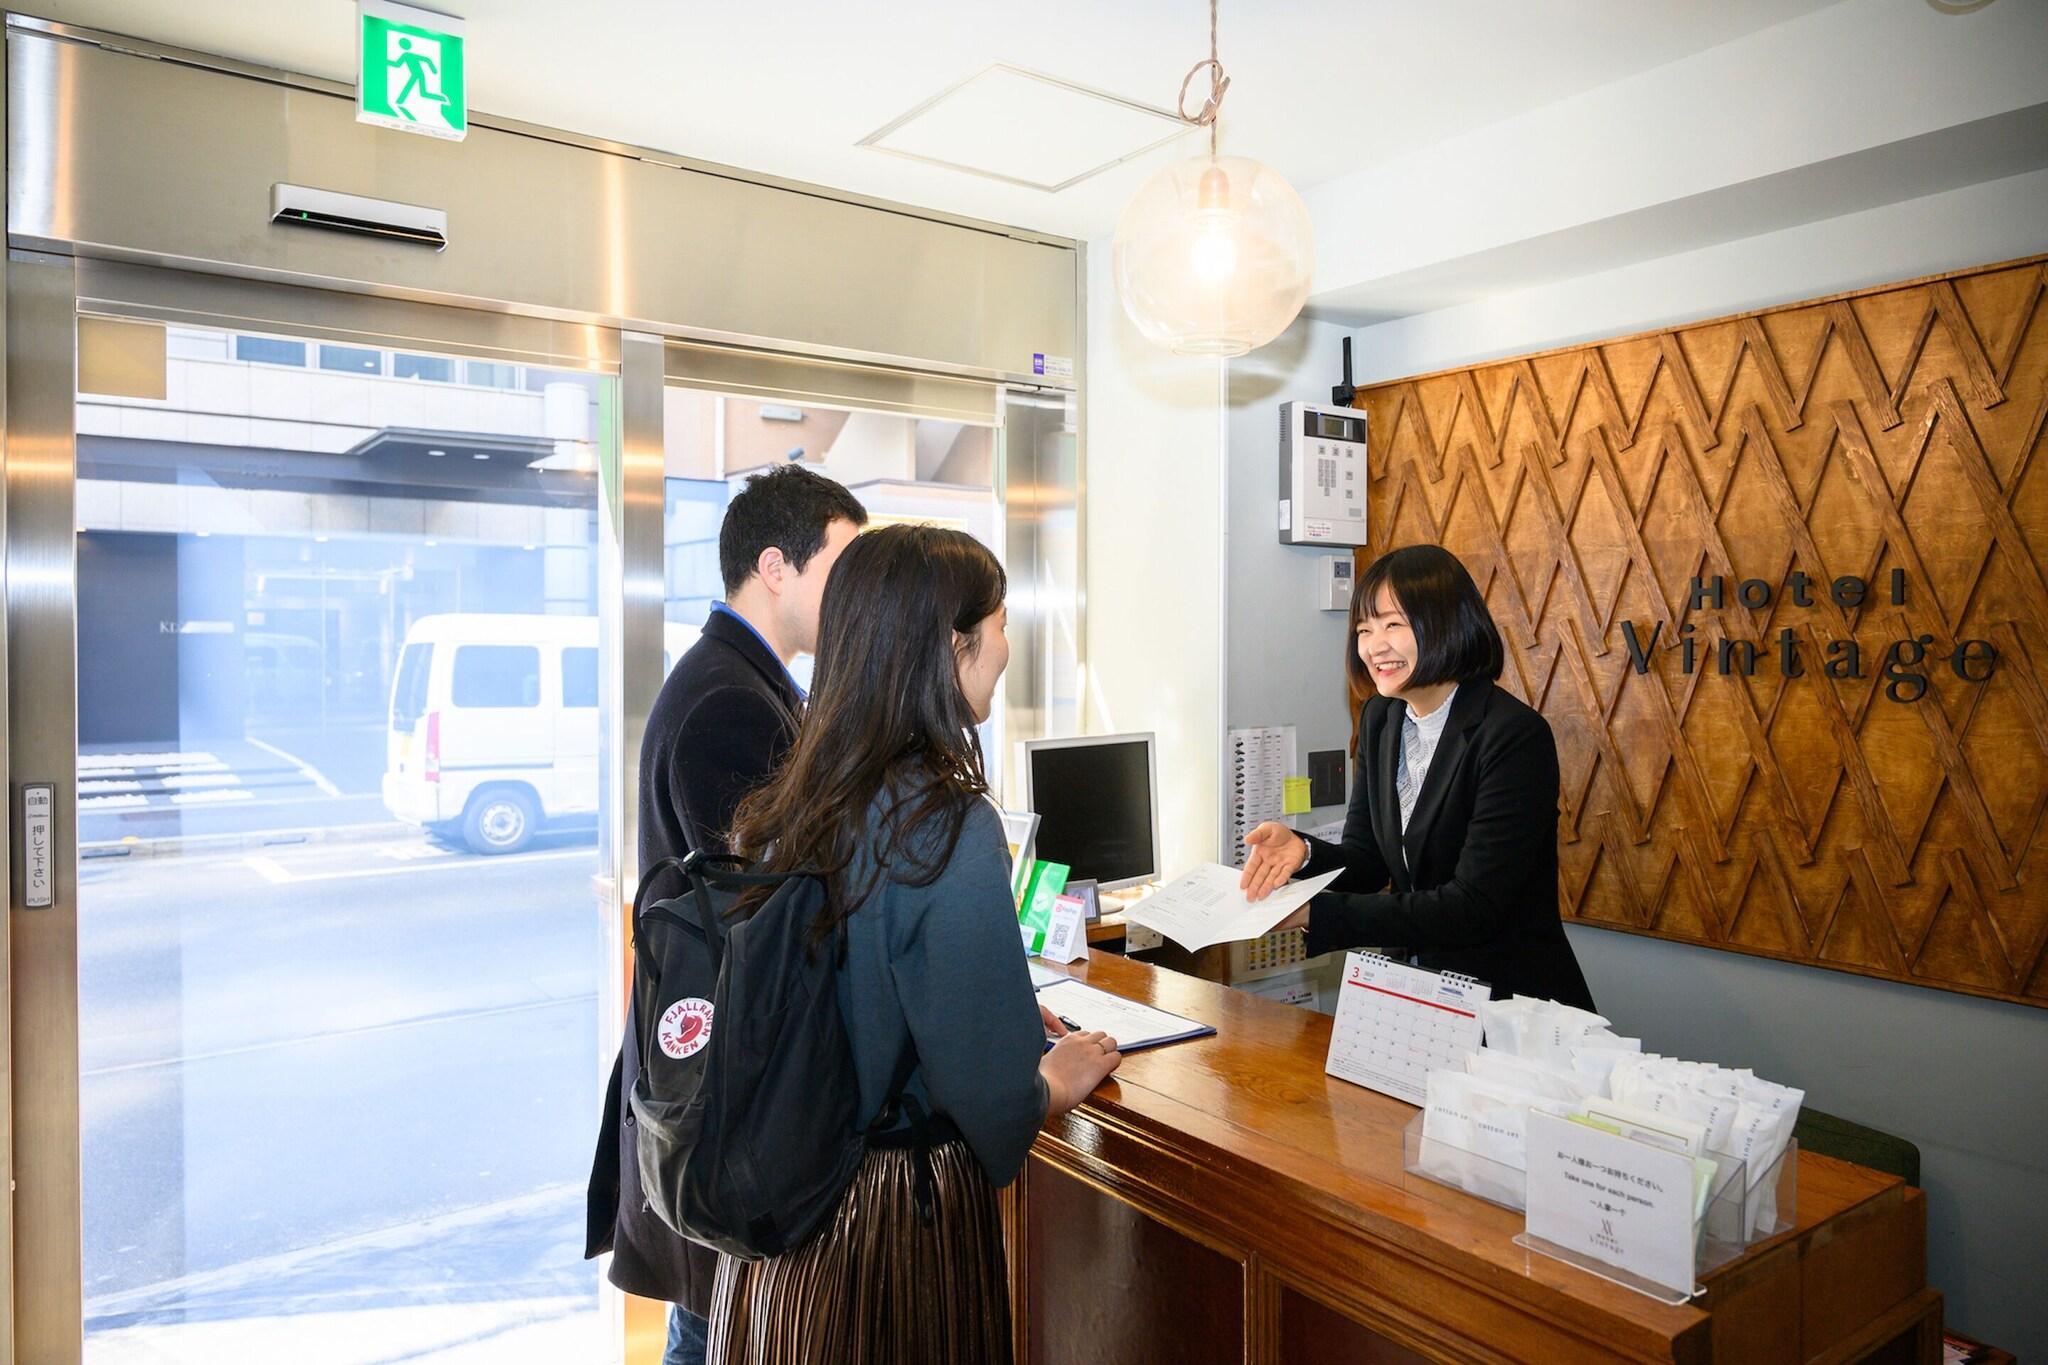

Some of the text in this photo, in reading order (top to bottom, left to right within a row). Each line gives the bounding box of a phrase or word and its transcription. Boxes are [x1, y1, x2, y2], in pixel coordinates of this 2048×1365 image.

[1691, 567, 1908, 610] Hotel
[1621, 619, 2000, 704] Vintage
[27, 796, 48, 806] 自動
[32, 824, 46, 889] 押して下さい
[27, 896, 50, 904] PUSH
[1352, 966, 1360, 978] 3
[1477, 1121, 1505, 1134] cotton
[1564, 1171, 1580, 1182] Take
[1581, 1178, 1595, 1188] one
[1595, 1182, 1607, 1191] for
[1607, 1187, 1625, 1198] each
